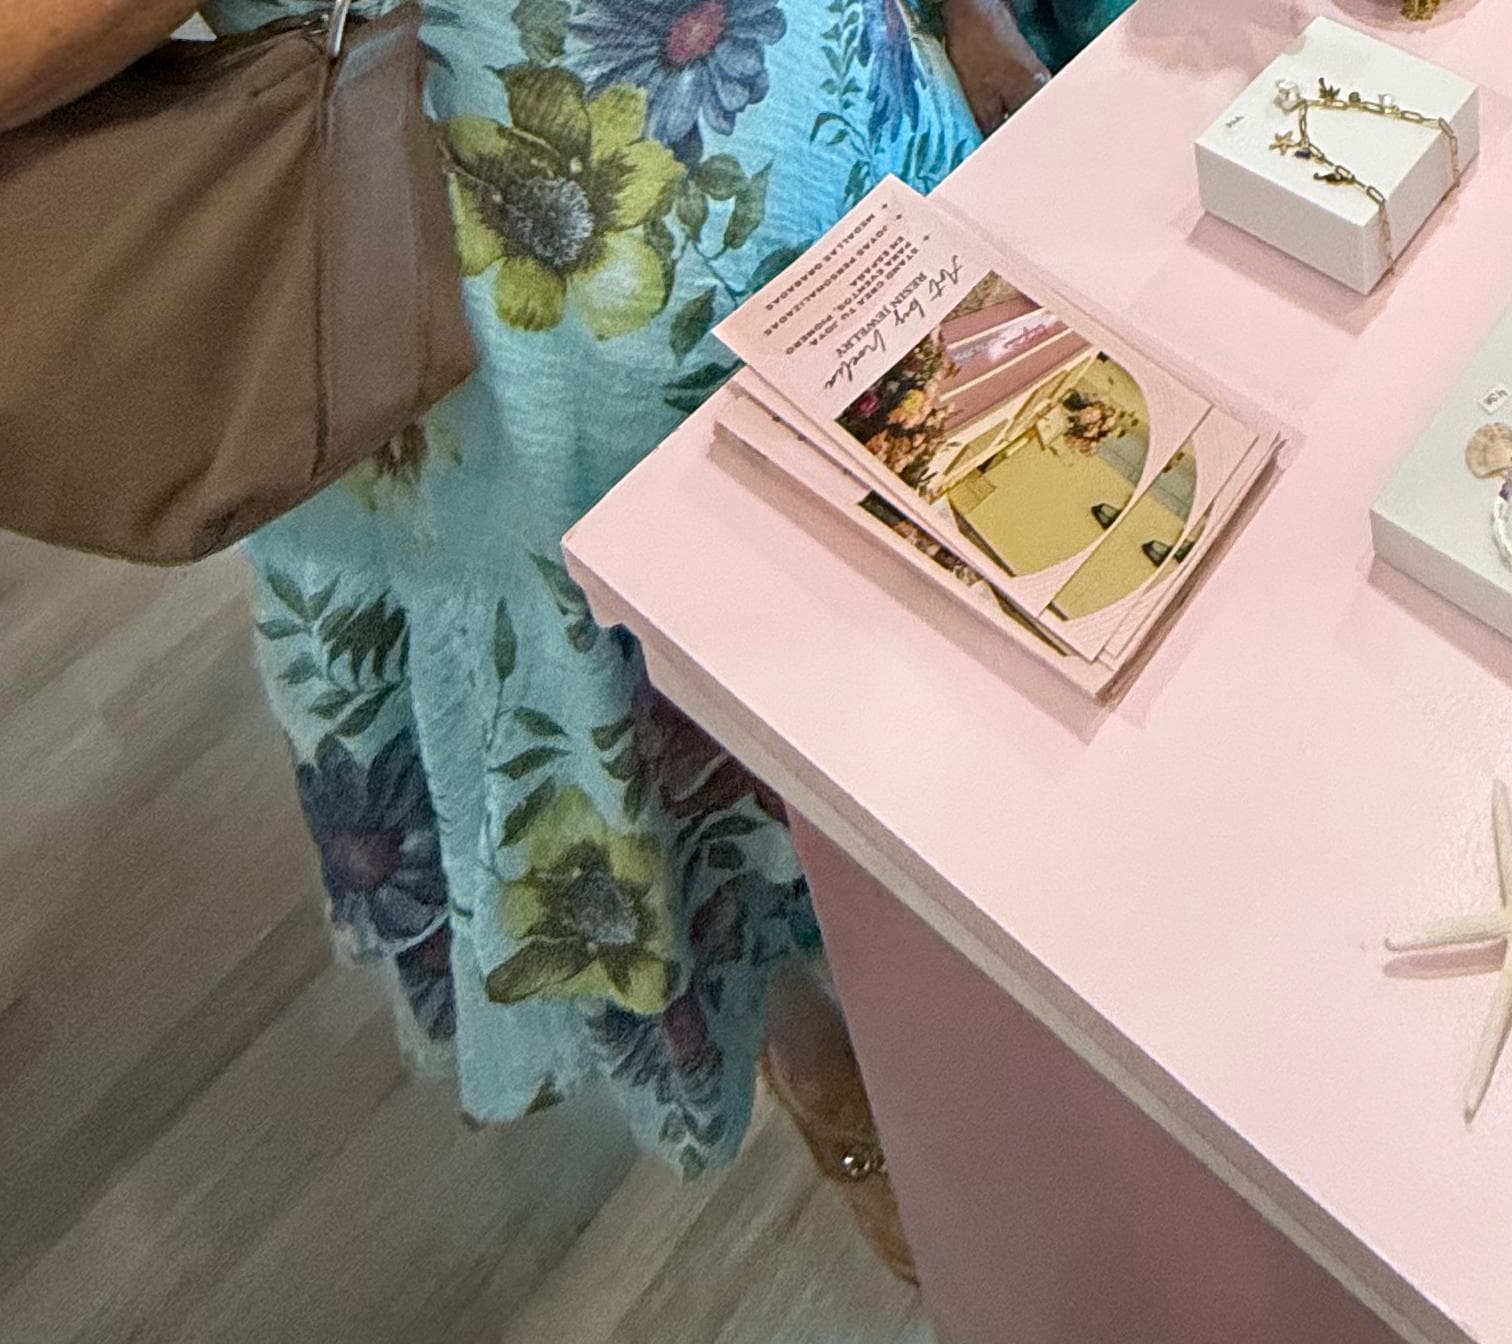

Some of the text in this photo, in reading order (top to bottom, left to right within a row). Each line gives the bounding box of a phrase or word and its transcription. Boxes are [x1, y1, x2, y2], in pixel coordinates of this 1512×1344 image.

[764, 212, 875, 311] MEDALLAS GRABADAS
[883, 241, 911, 266] PARA
[889, 235, 904, 250] EN
[763, 224, 887, 336] JOYAS PERSONALIZADAS
[808, 247, 918, 346] STAND CREA TU JOYA
[928, 254, 962, 301] Art
[784, 314, 833, 355] PIONERO
[835, 271, 927, 358] RESIN JEWELRY
[893, 297, 925, 326] by
